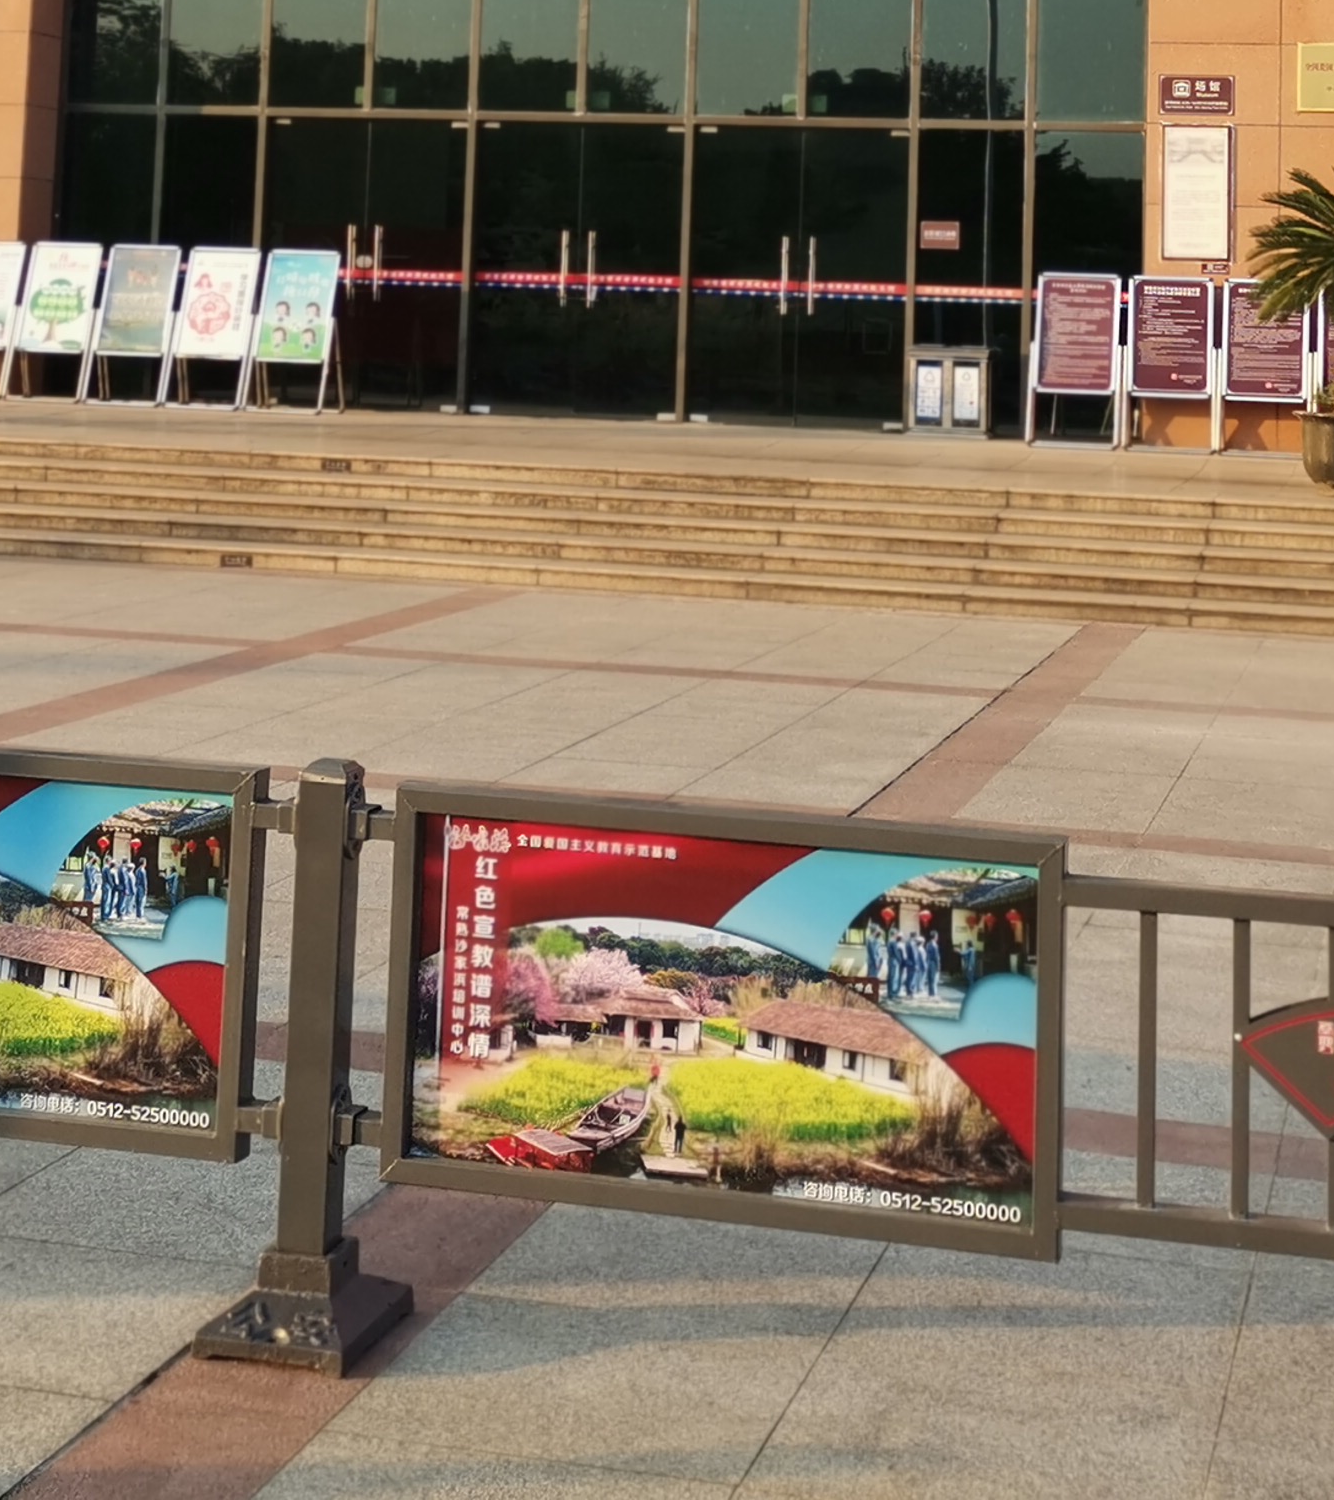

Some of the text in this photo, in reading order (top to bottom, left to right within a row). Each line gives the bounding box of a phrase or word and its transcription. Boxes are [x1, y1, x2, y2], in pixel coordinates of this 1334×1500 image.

[517, 833, 678, 860] 全国爱国主义教育示范基地
[467, 856, 499, 1059] 红色宣教谱深情
[450, 906, 470, 1055] 常熟沙家浜培训中心
[87, 1100, 210, 1128] 0512-52500000
[879, 1190, 1021, 1223] 0512-52500000
